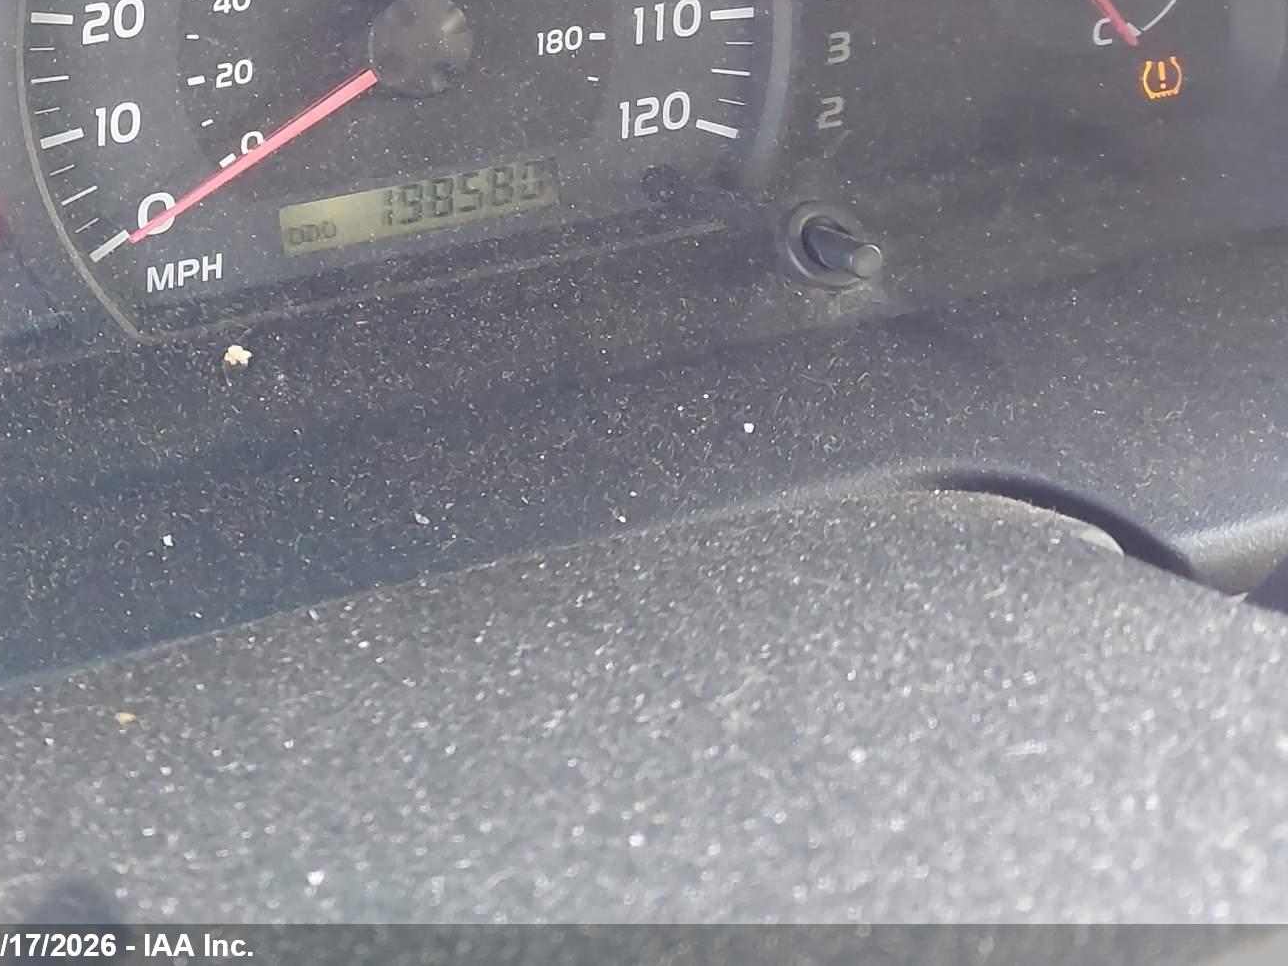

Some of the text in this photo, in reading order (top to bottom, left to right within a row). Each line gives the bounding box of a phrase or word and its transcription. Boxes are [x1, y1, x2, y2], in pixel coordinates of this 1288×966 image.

[537, 25, 583, 56] 180
[827, 31, 851, 64] 3
[215, 59, 253, 89] 20
[95, 102, 141, 147] 10
[619, 91, 691, 139] 120
[815, 96, 845, 130] 2
[137, 192, 177, 235] 0
[147, 253, 223, 293] MPH
